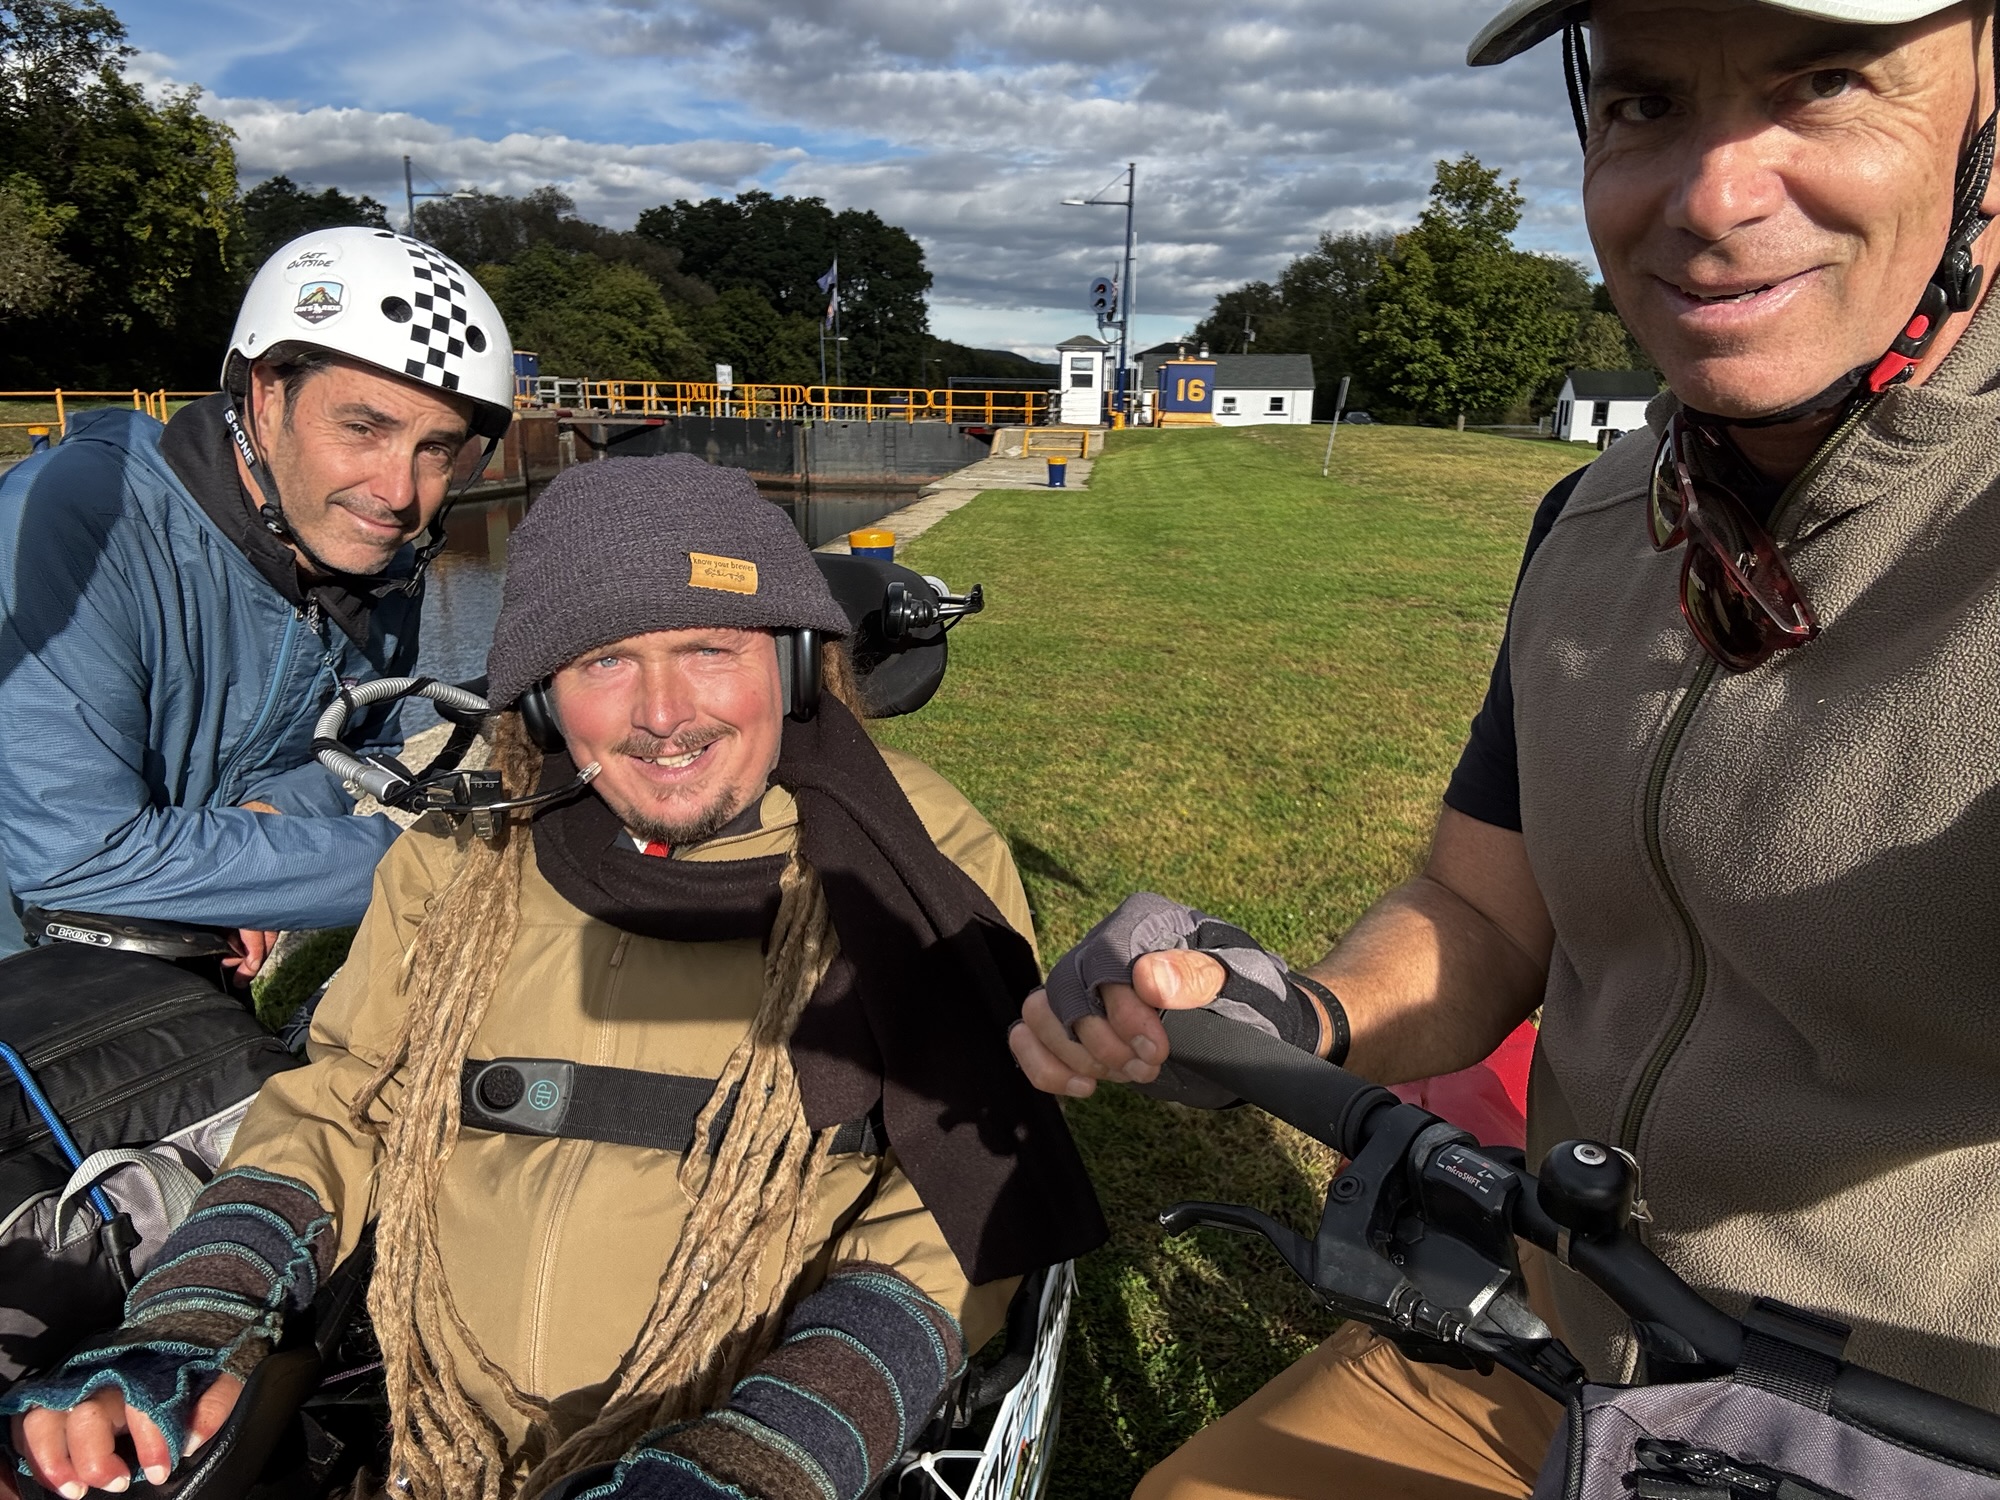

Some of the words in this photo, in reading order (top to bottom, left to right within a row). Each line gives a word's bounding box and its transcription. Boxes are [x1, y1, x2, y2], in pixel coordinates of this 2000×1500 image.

[299, 252, 327, 260] GET
[287, 260, 334, 270] OUTSIDE
[1177, 378, 1206, 402] 16
[693, 557, 712, 566] know
[731, 561, 755, 571] brewer
[58, 928, 98, 943] BROOKS
[1445, 1165, 1481, 1188] microSHIFT
